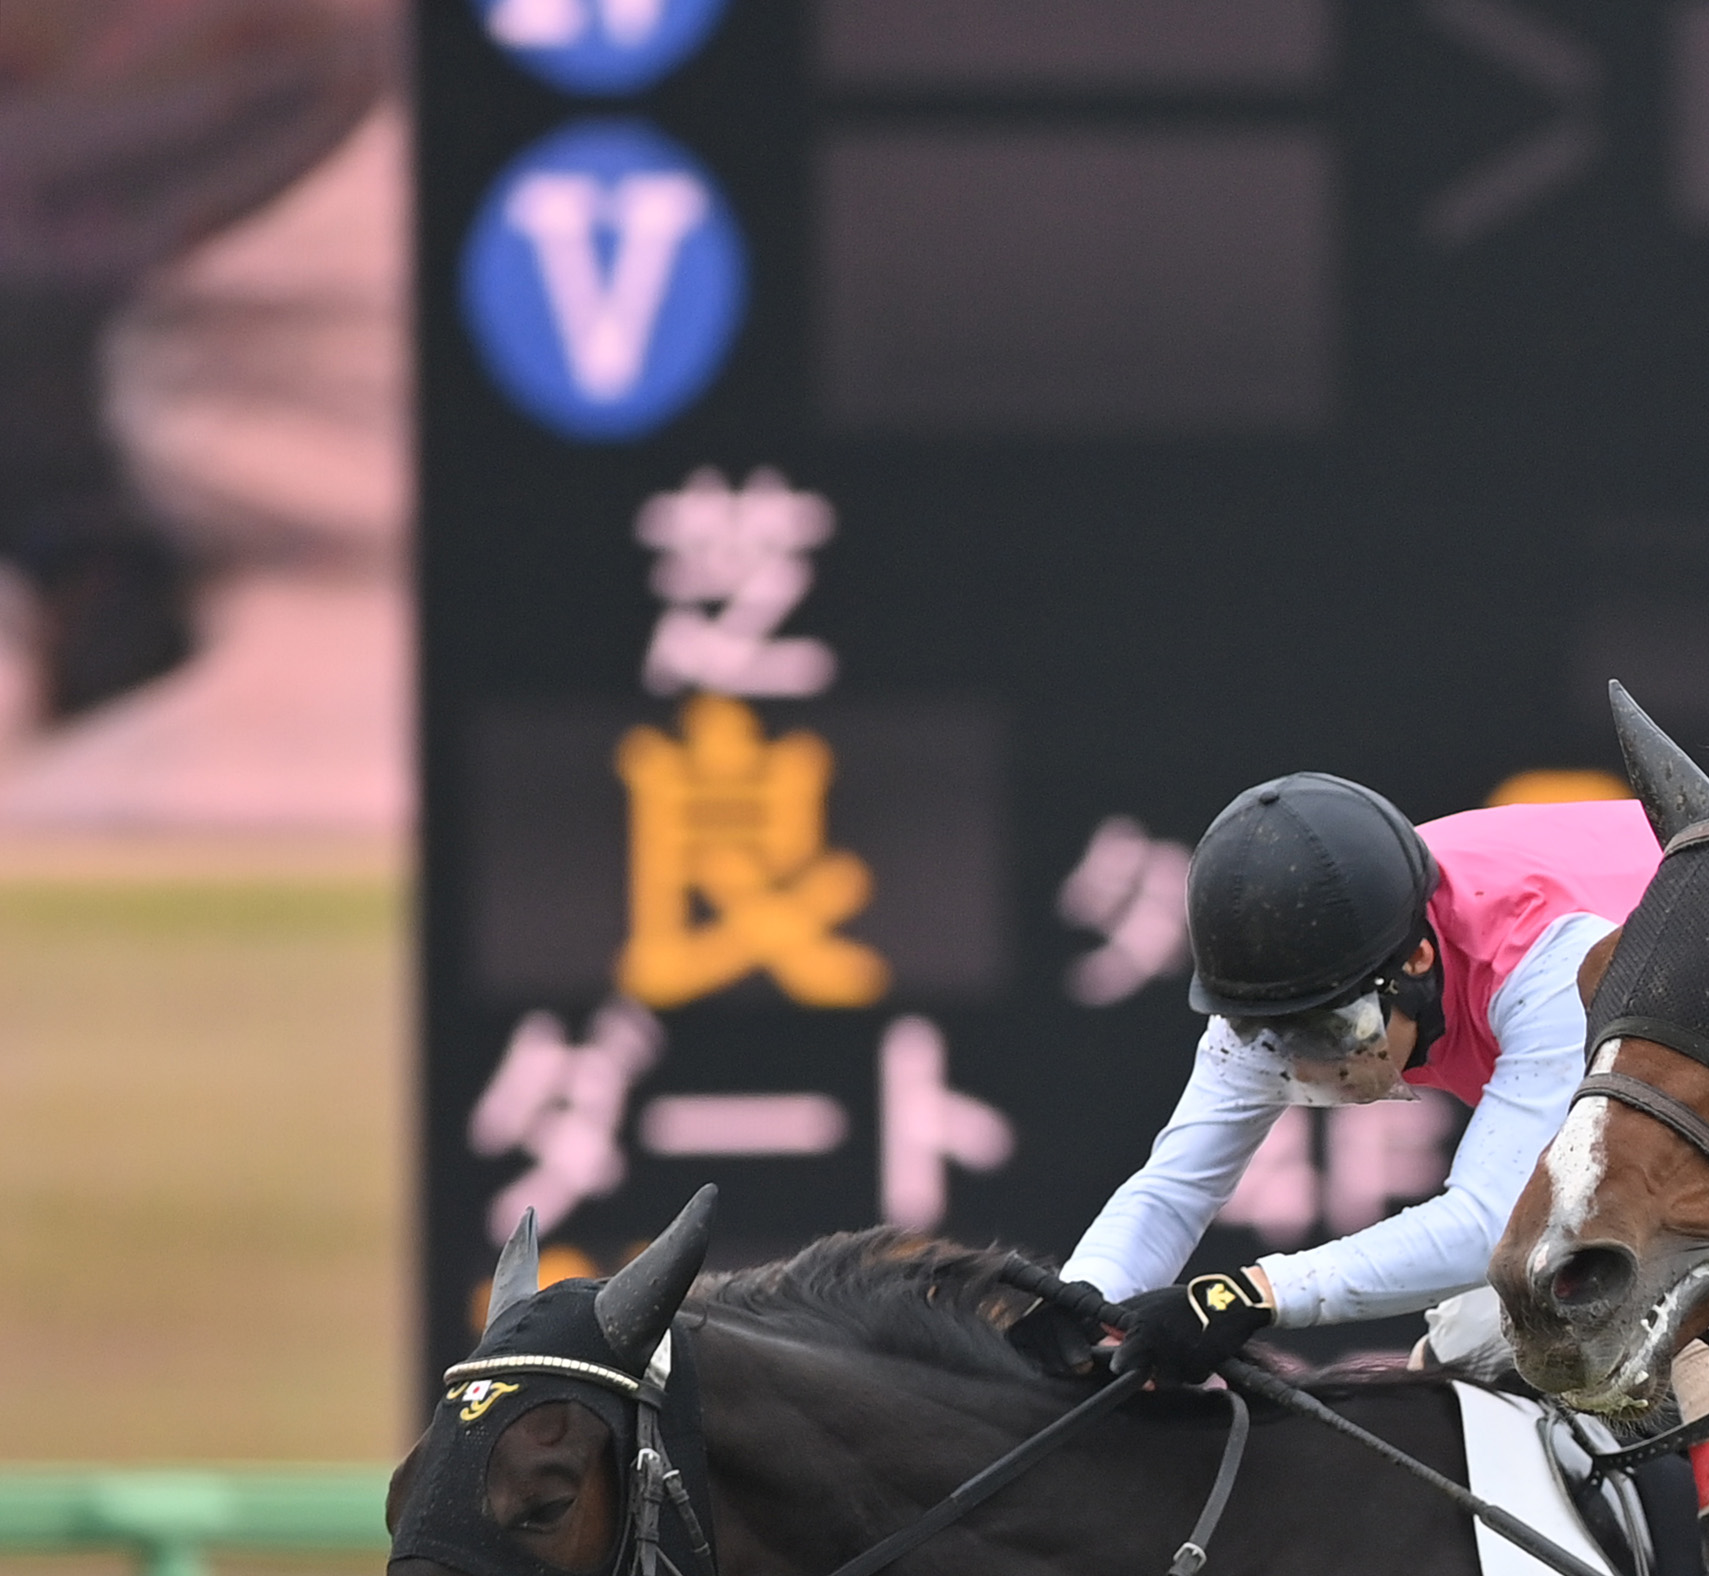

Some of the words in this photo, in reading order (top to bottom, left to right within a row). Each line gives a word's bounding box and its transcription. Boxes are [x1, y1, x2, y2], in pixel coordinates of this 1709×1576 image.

[636, 466, 836, 697] 芝
[618, 697, 888, 1007] 良
[468, 1006, 1014, 1246] ダート
